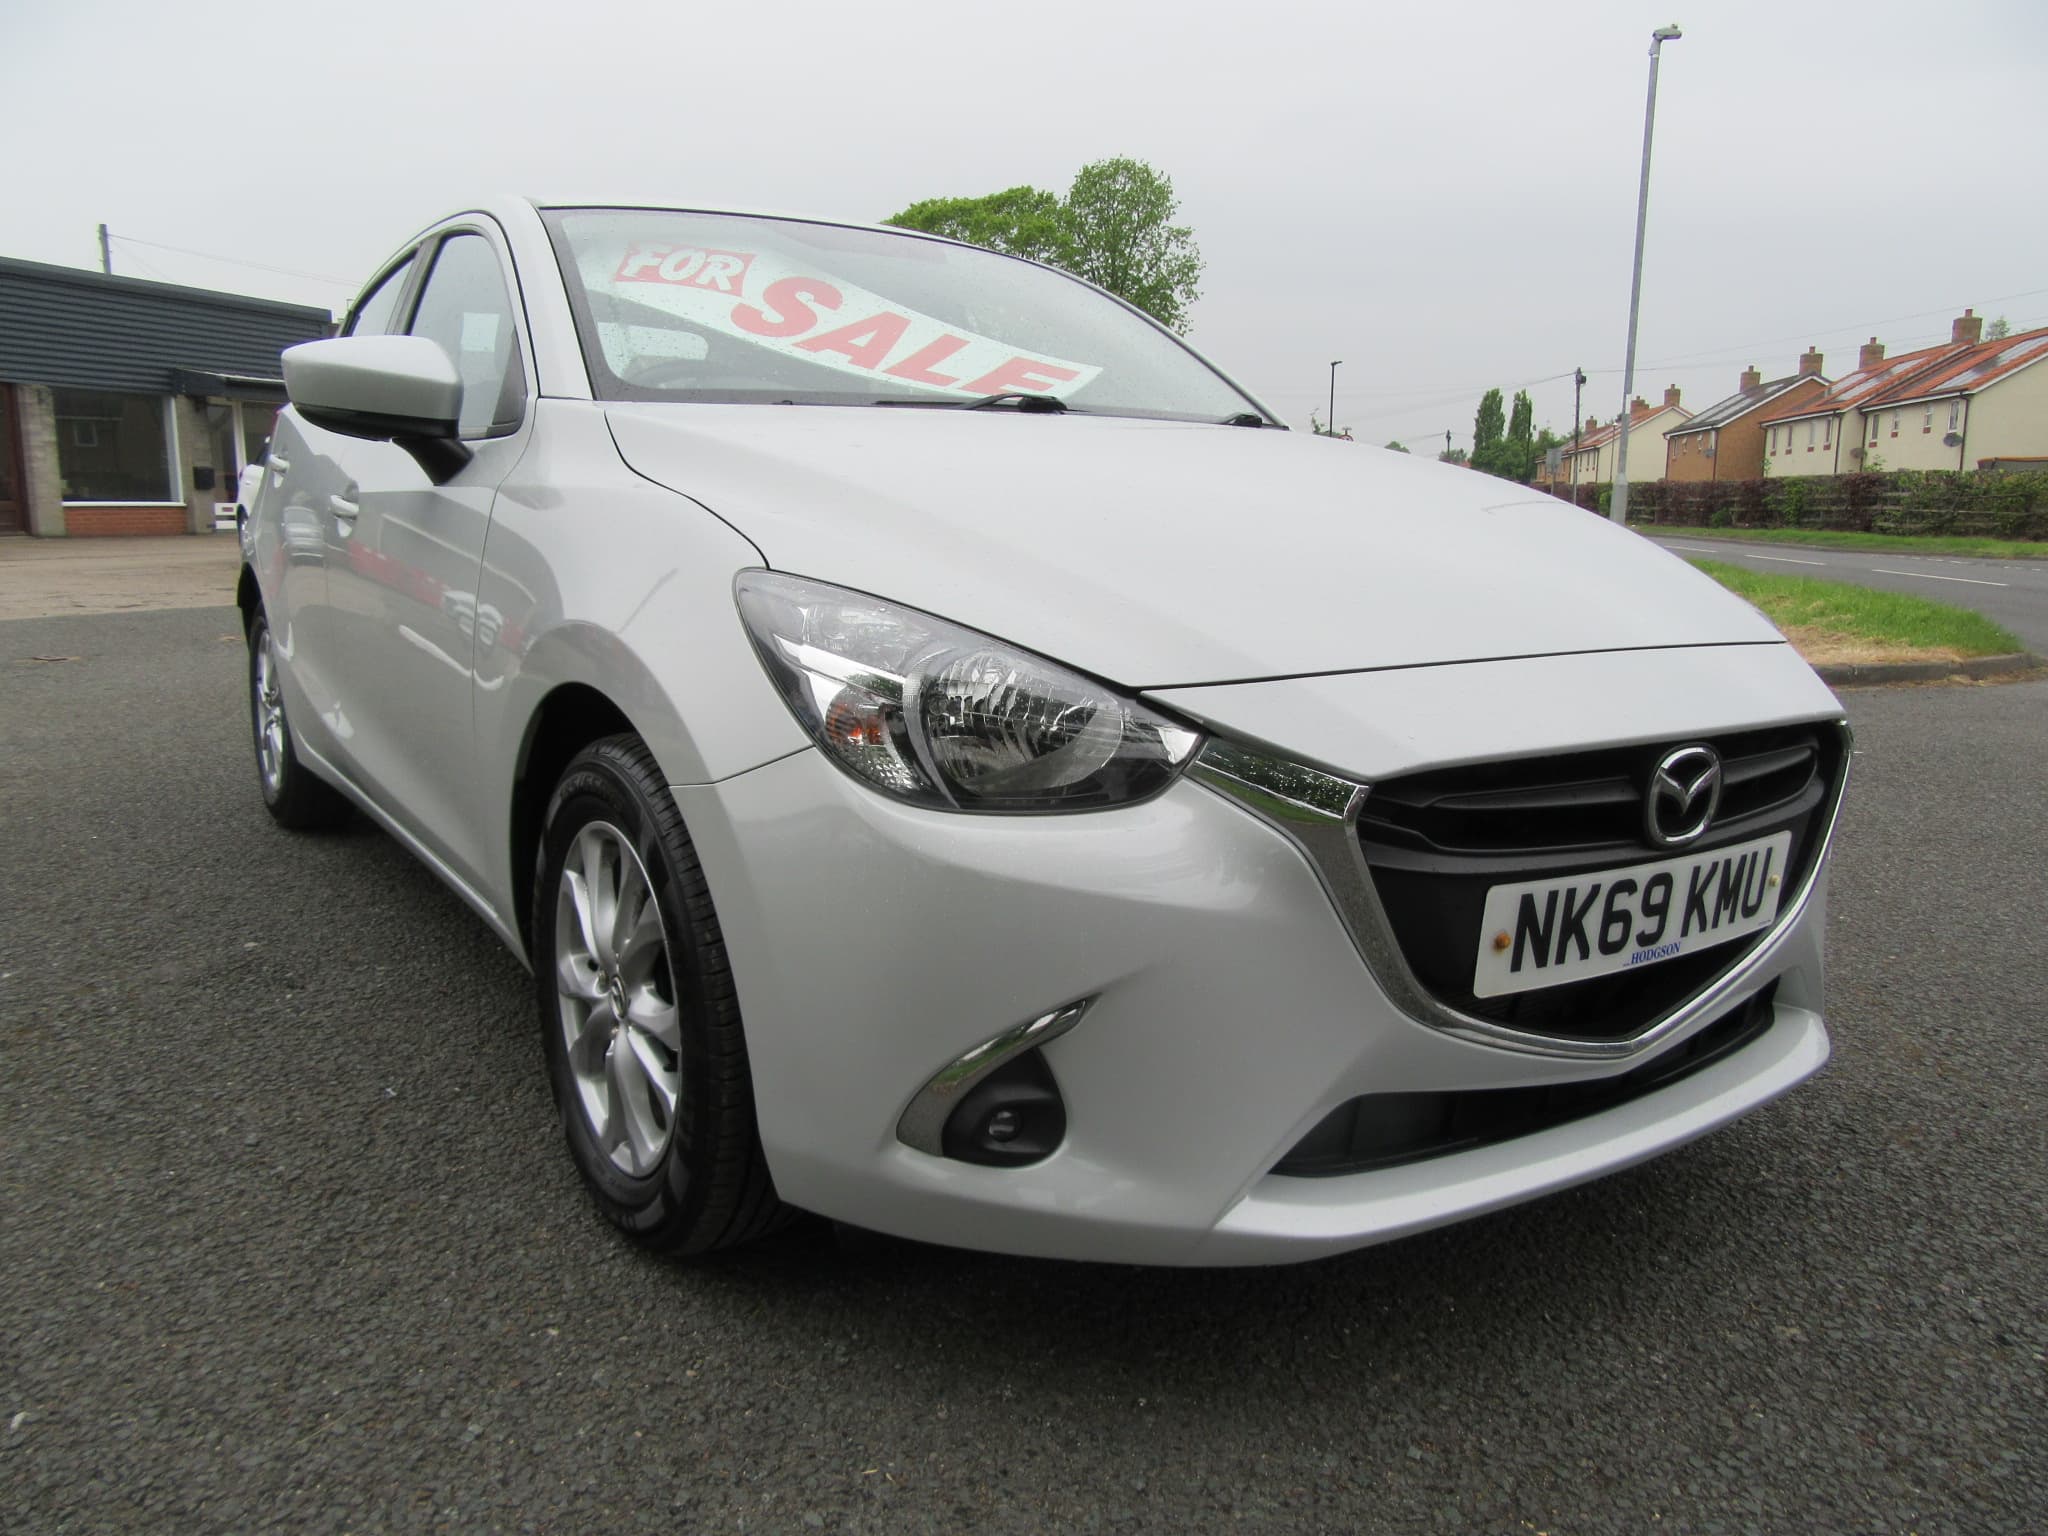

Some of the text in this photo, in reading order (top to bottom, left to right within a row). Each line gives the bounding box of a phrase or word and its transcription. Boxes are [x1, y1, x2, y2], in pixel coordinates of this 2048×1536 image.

[621, 246, 1080, 397] FOR SALE
[1510, 847, 1773, 972] NK69 KMU
[1631, 942, 1681, 965] HODGSON
